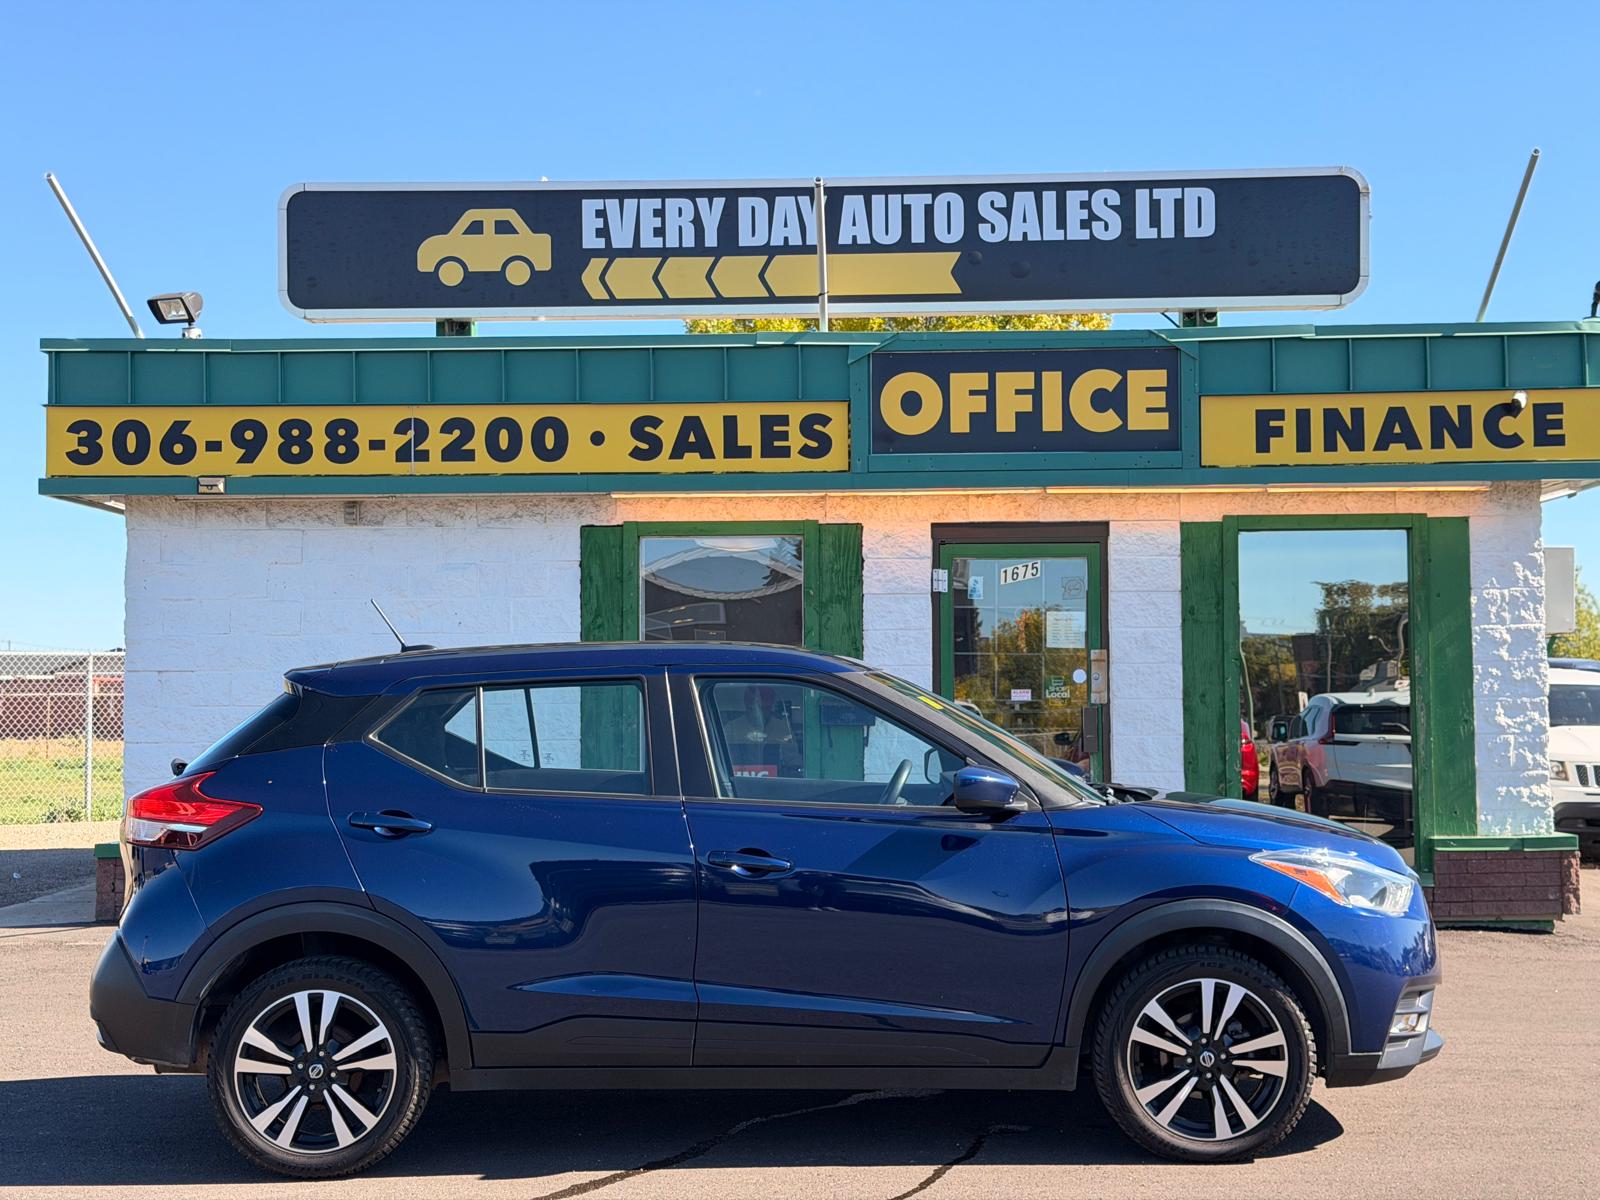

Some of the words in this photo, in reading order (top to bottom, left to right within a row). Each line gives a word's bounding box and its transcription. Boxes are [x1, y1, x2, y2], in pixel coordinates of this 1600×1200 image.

[582, 196, 726, 249] EVERY
[738, 194, 827, 248] DAY
[838, 192, 965, 246] AUTO
[977, 189, 1123, 243] SALES
[1135, 187, 1216, 240] LTD
[880, 368, 1170, 436] OFFICE
[1255, 401, 1566, 454] FINANCE
[65, 416, 569, 466] 306-988-2200
[628, 412, 833, 462] SALES
[1002, 561, 1039, 584] 1675
